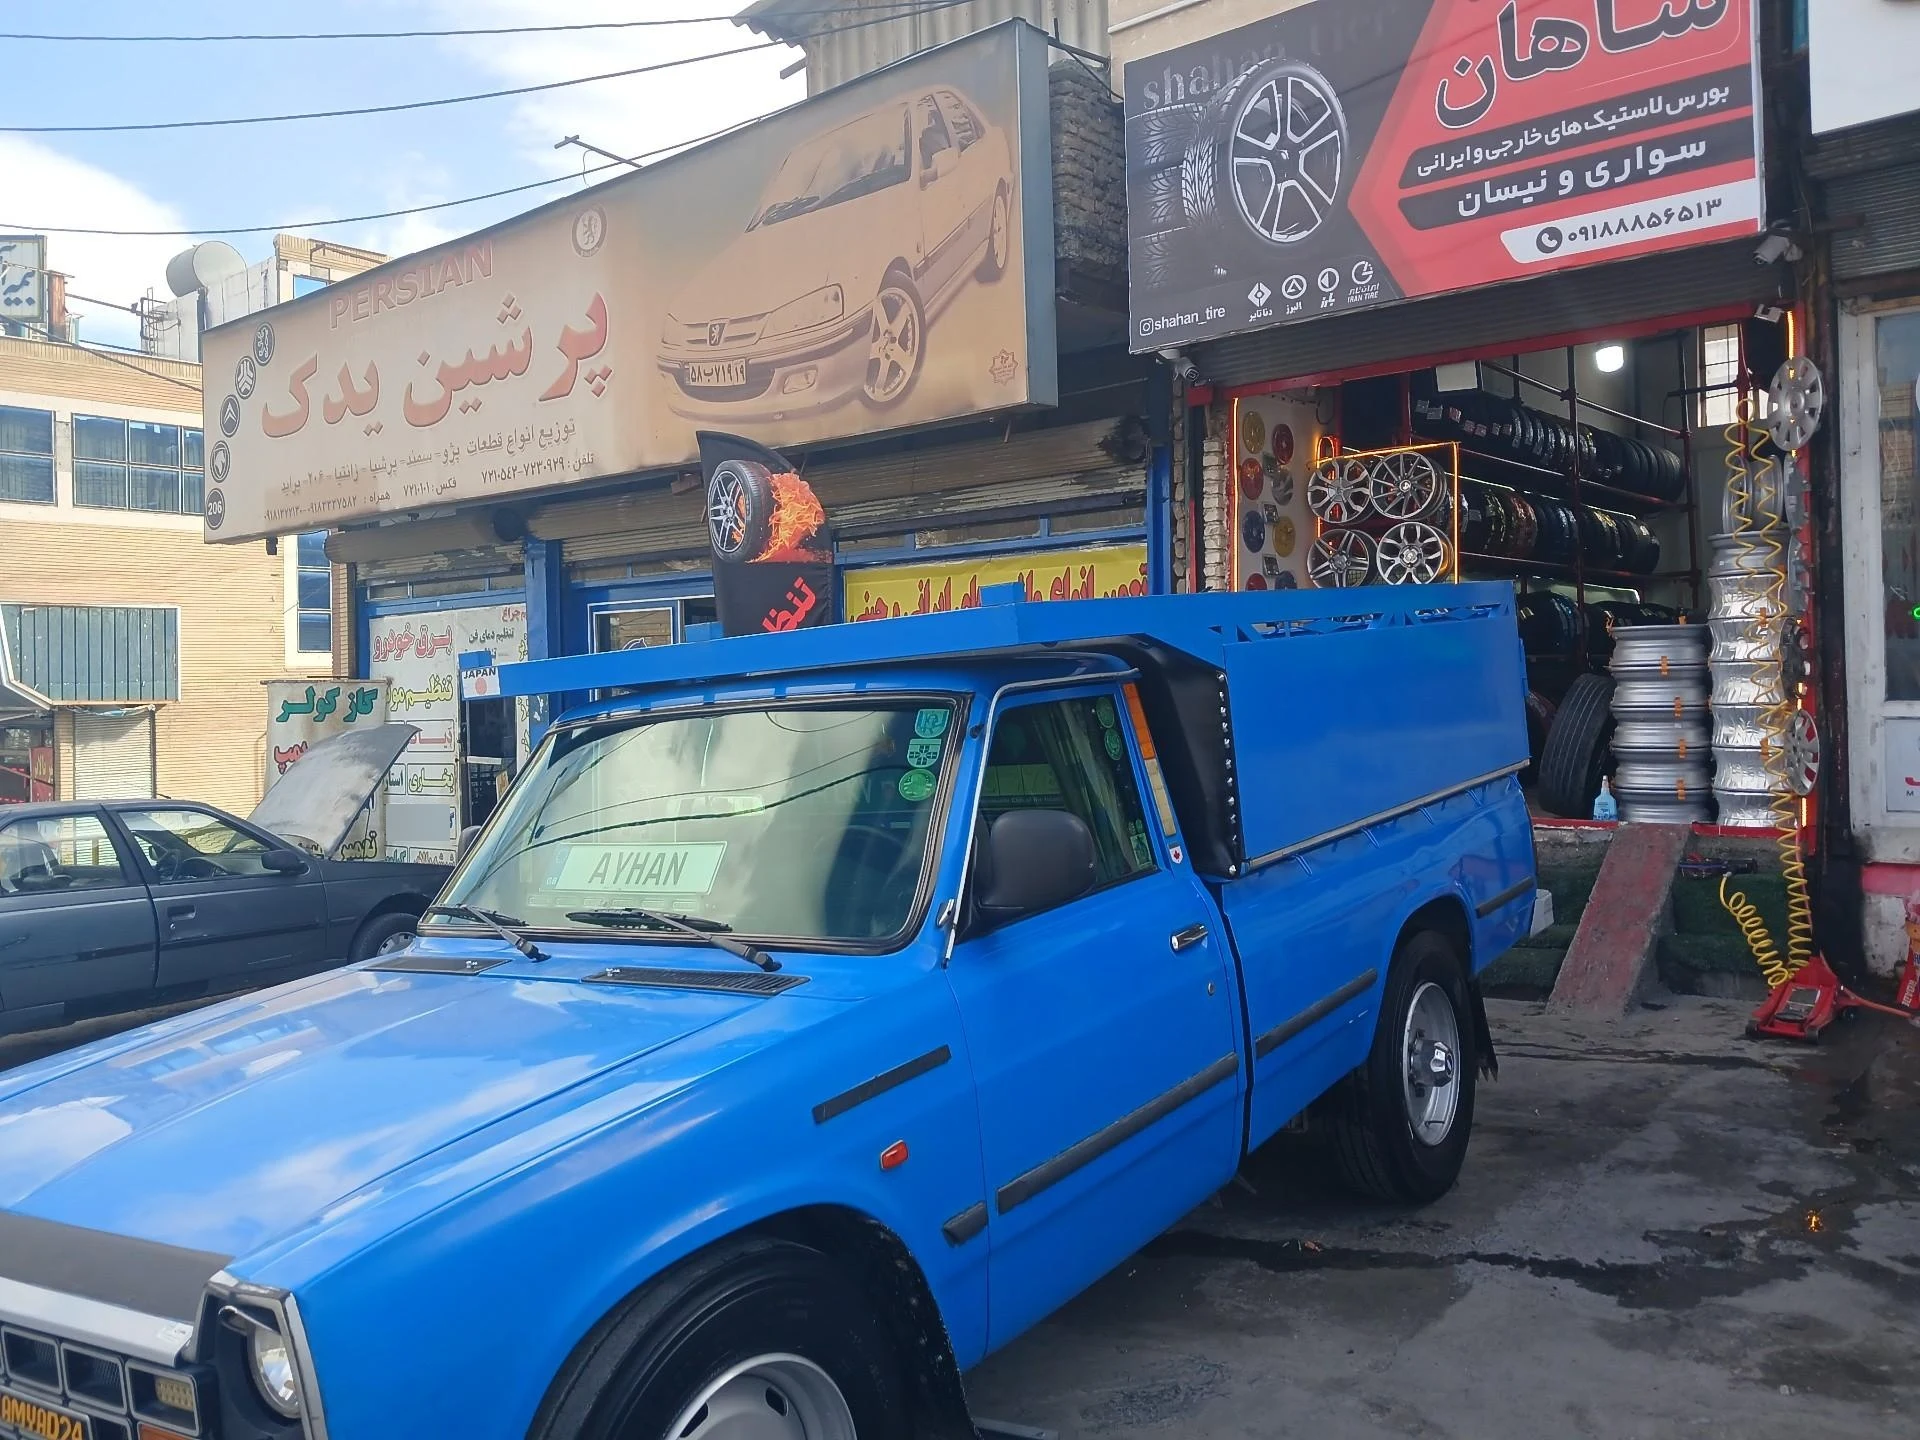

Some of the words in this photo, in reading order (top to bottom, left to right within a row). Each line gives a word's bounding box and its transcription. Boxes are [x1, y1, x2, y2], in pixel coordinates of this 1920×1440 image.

[1665, 84, 1730, 116] بورس
[1472, 145, 1484, 164] و
[1485, 127, 1543, 161] خارجی
[1416, 145, 1471, 177] ایرانی
[1584, 140, 1707, 189] سواری
[1457, 168, 1548, 218] نیسان
[1558, 168, 1575, 196] و
[1567, 197, 1722, 243] ۰۹۱۸۸۸۵۶۵۱۳
[330, 239, 496, 330] PERSIAN
[1347, 294, 1363, 304] IRAN
[1364, 290, 1379, 301] TIRE
[1154, 306, 1226, 331] shahan_tire
[402, 291, 614, 428] پرشین
[261, 352, 384, 438] یدک
[466, 431, 503, 454] قطعات
[506, 424, 535, 455] انواع
[538, 418, 577, 449] توزیع
[207, 501, 222, 516] 206
[373, 622, 416, 662] خودرو
[414, 624, 454, 660] برق
[463, 667, 497, 680] JAPAN
[276, 685, 341, 723] کولر
[343, 686, 378, 722] گاز
[408, 768, 455, 793] بخاری
[588, 851, 689, 886] AYHAN
